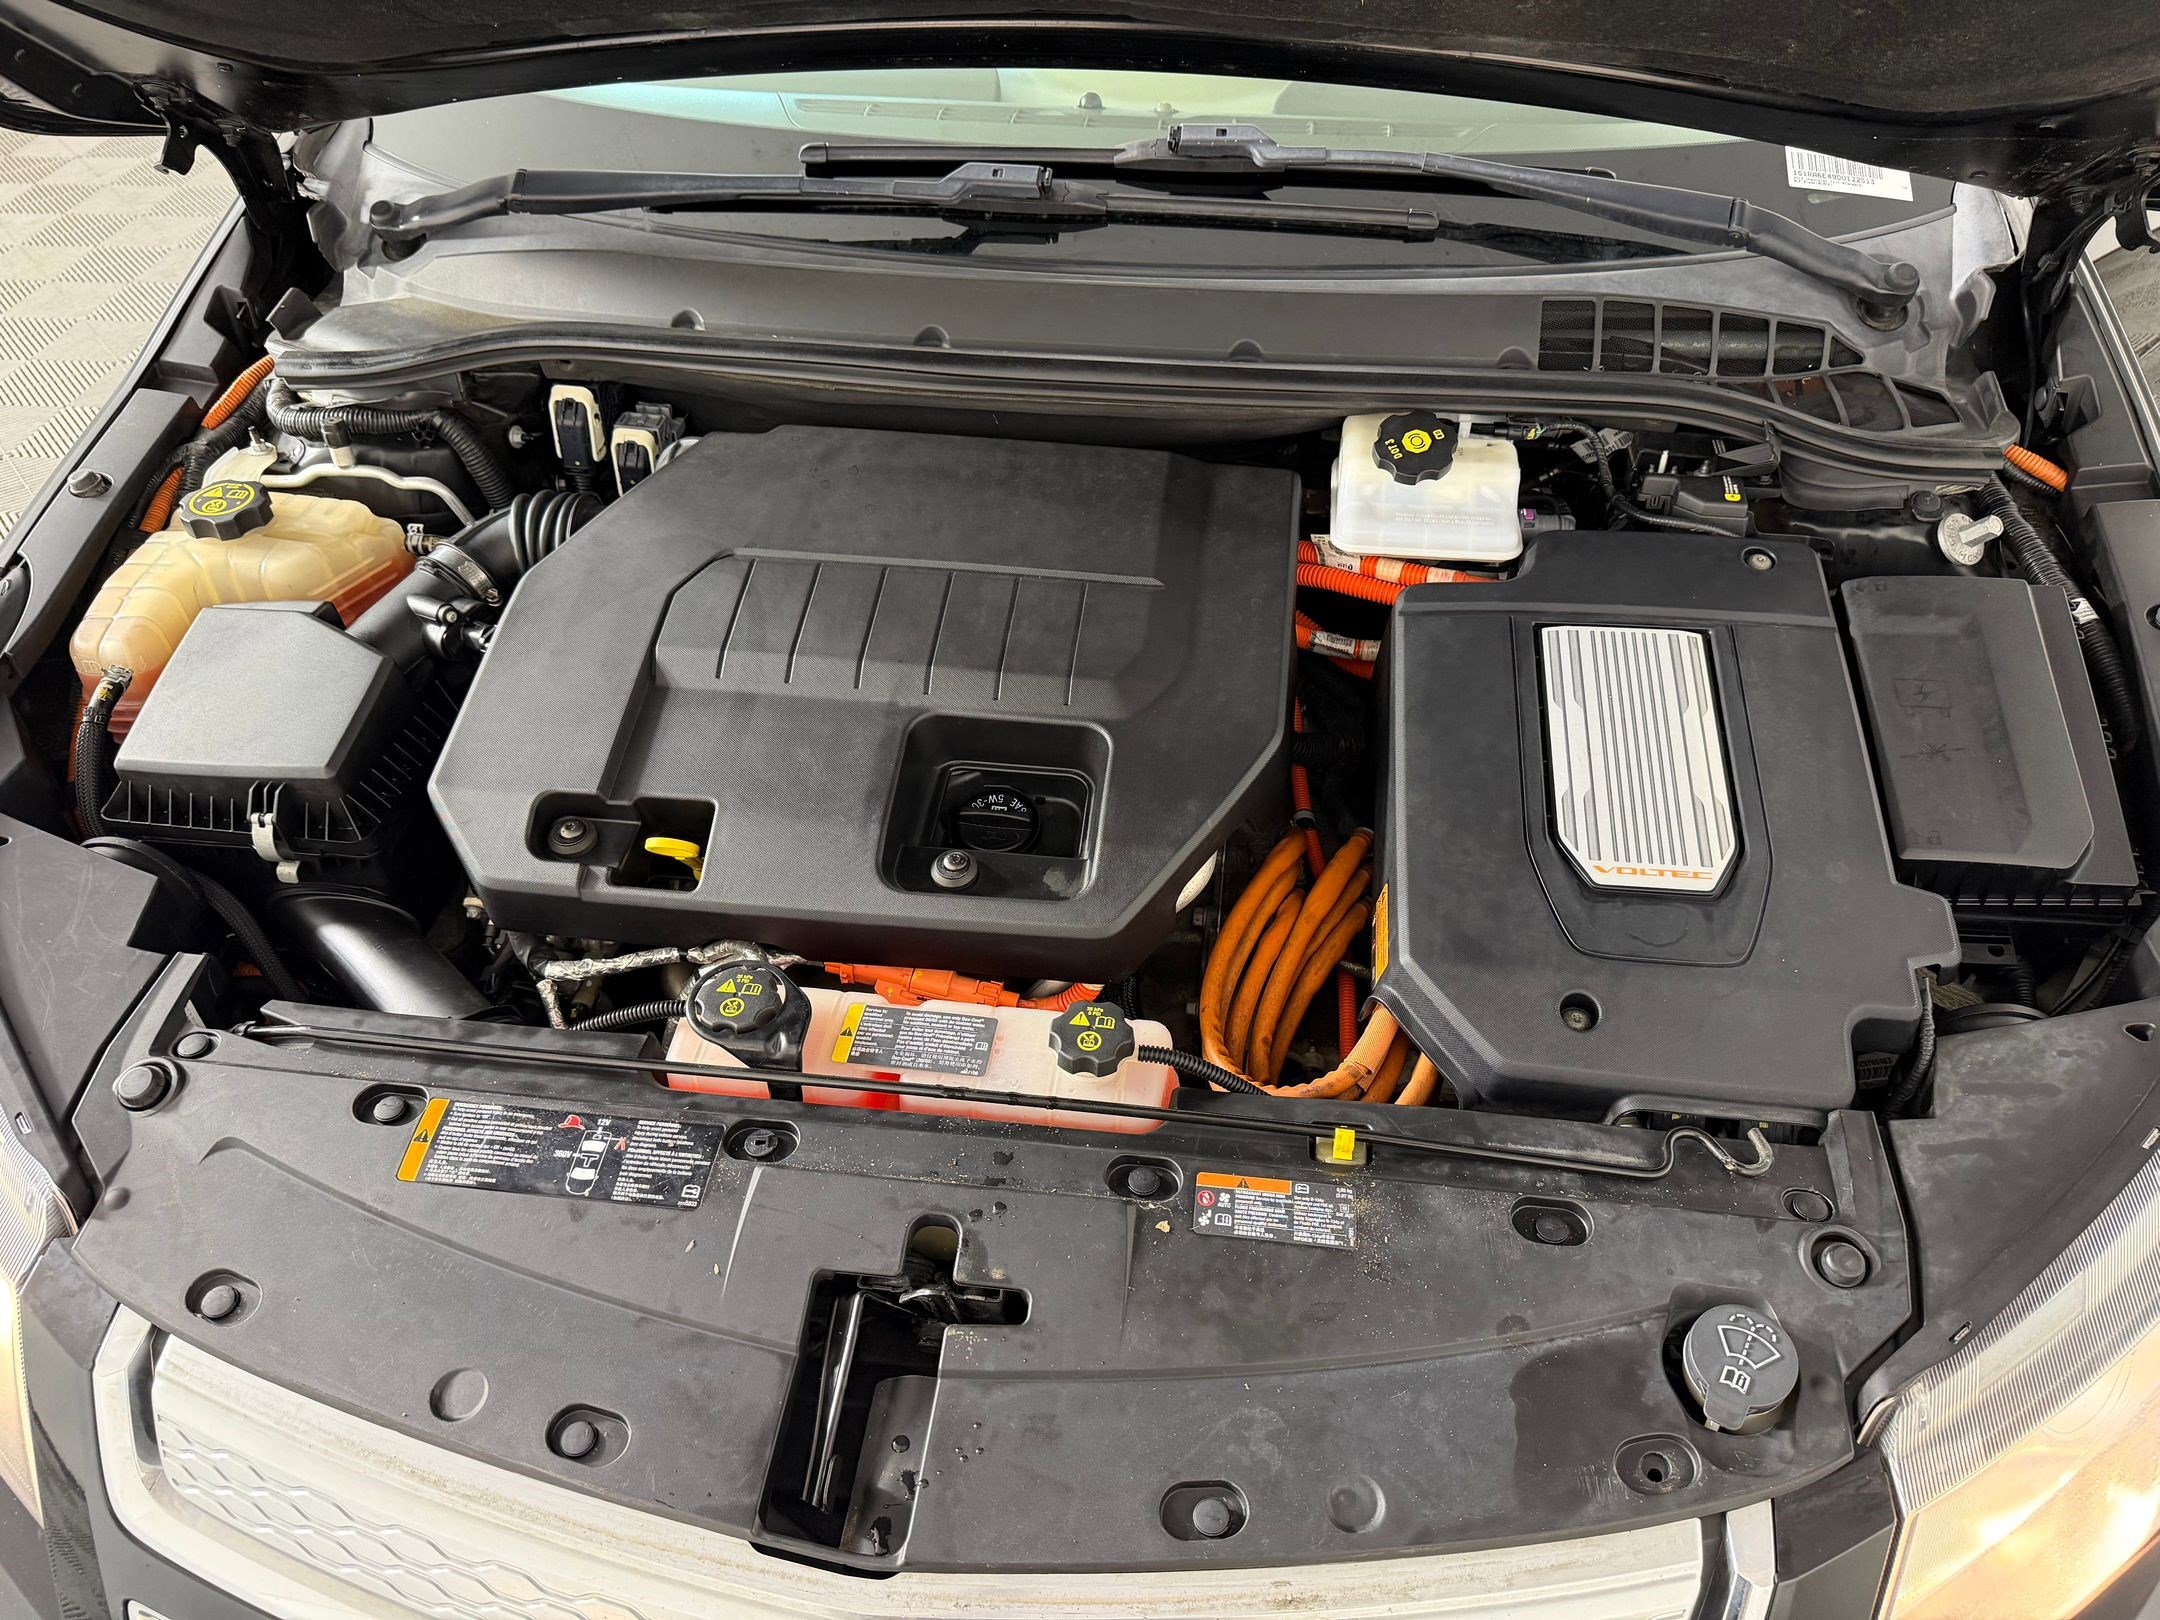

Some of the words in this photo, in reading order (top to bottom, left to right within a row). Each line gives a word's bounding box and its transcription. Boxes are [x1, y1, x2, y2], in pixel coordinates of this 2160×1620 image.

[1794, 170, 1875, 184] 1G1RA6E49DU122513
[1592, 865, 1713, 880] VOLTEC
[552, 1149, 572, 1158] 360V
